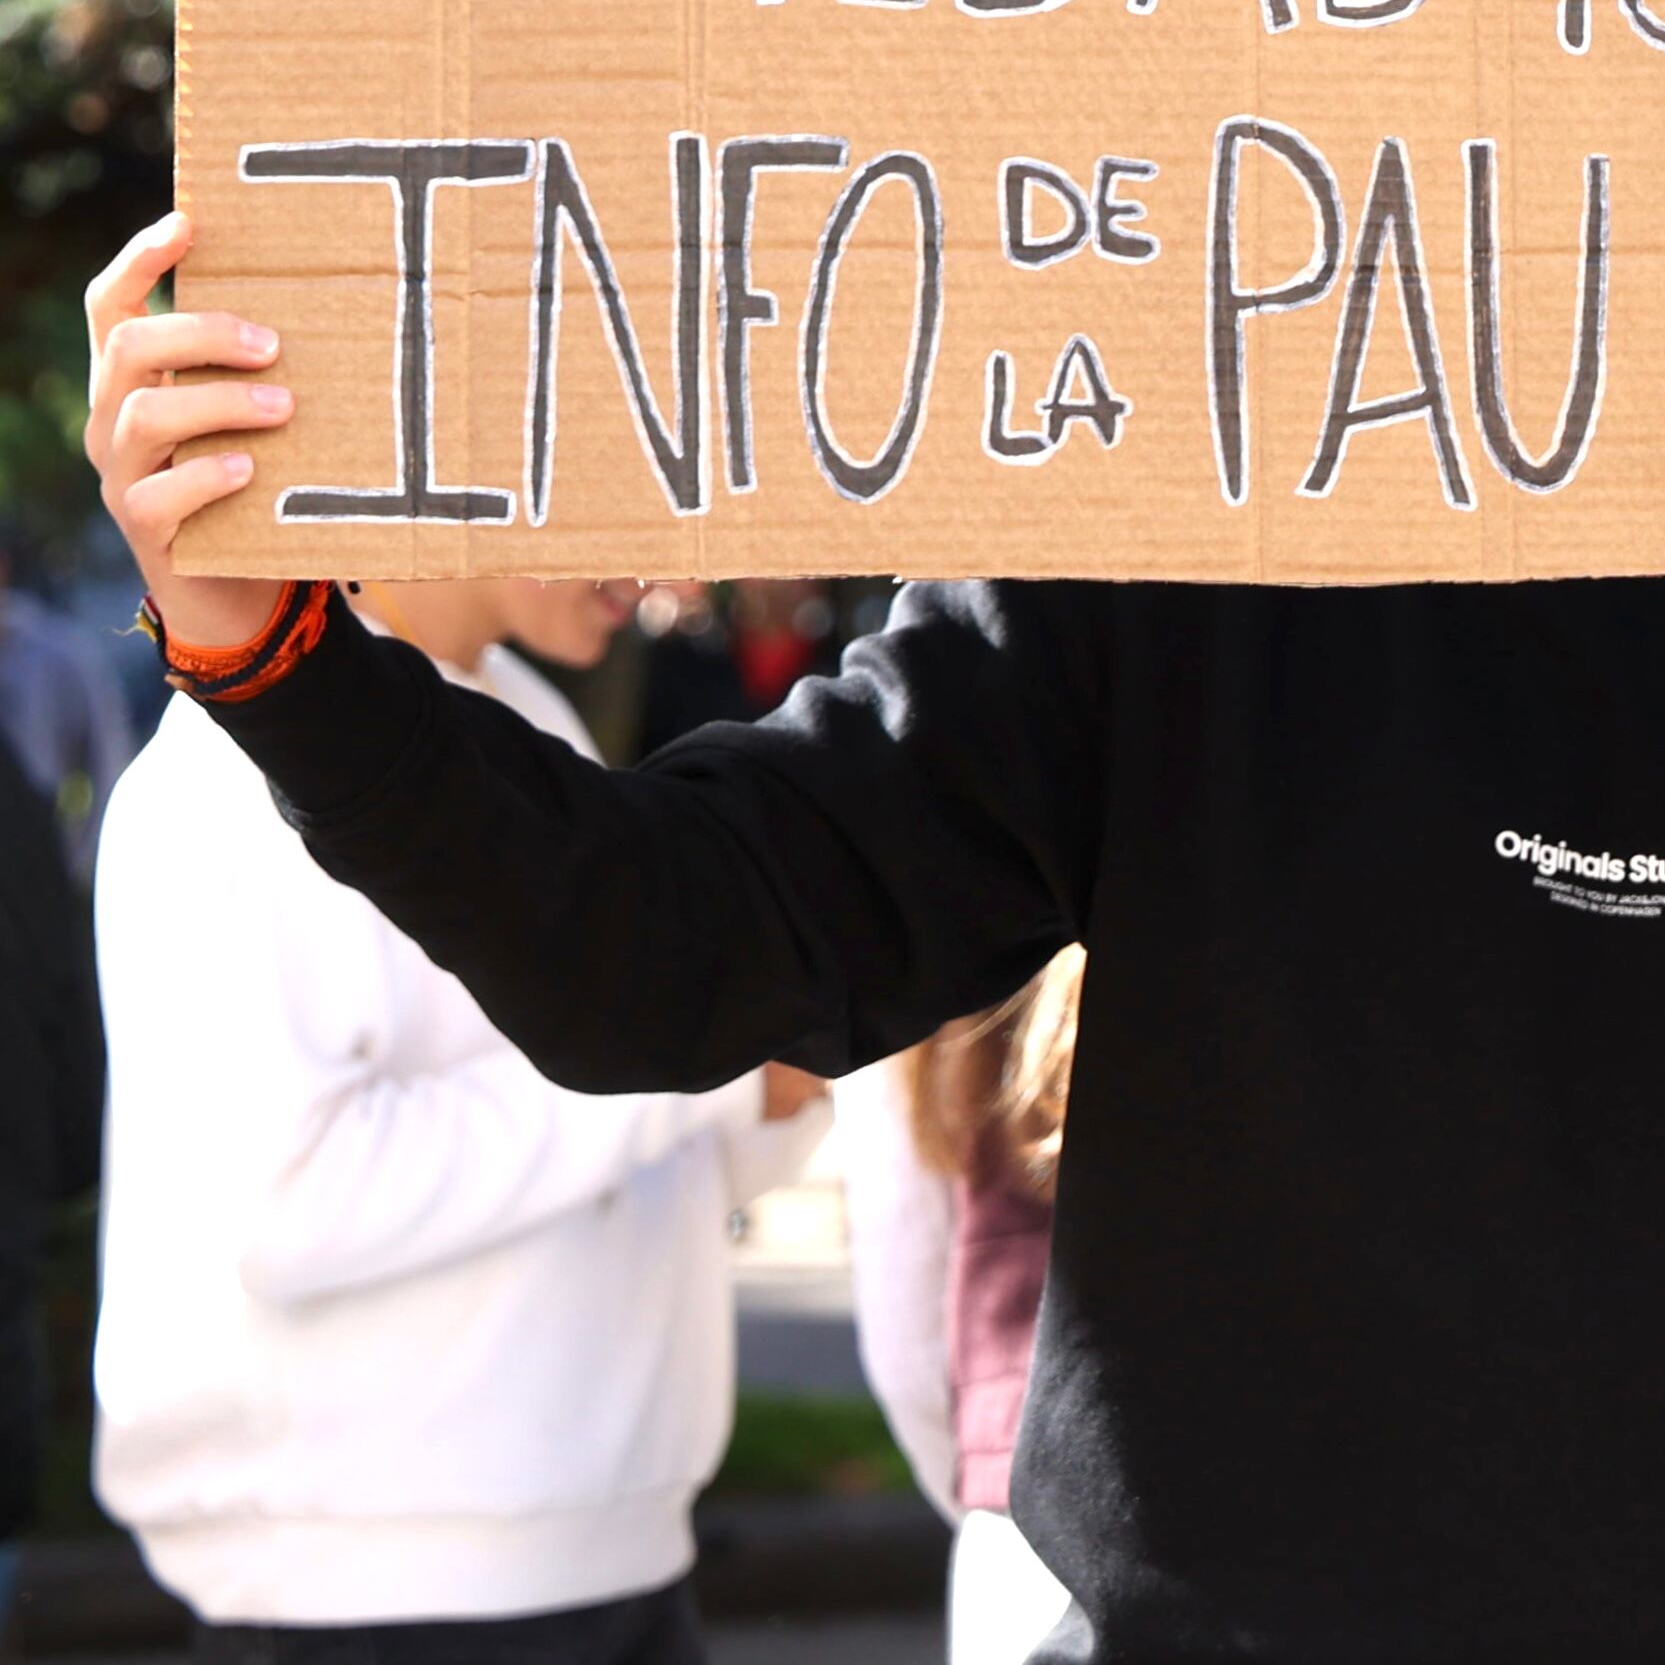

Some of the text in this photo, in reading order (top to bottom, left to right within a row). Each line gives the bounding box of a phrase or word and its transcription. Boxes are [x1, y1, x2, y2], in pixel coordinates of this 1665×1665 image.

[1000, 155, 1162, 271] DE
[236, 132, 947, 527] INFO
[1205, 112, 1614, 512] PAU
[983, 331, 1134, 466] LA
[1495, 830, 1625, 882] Originals
